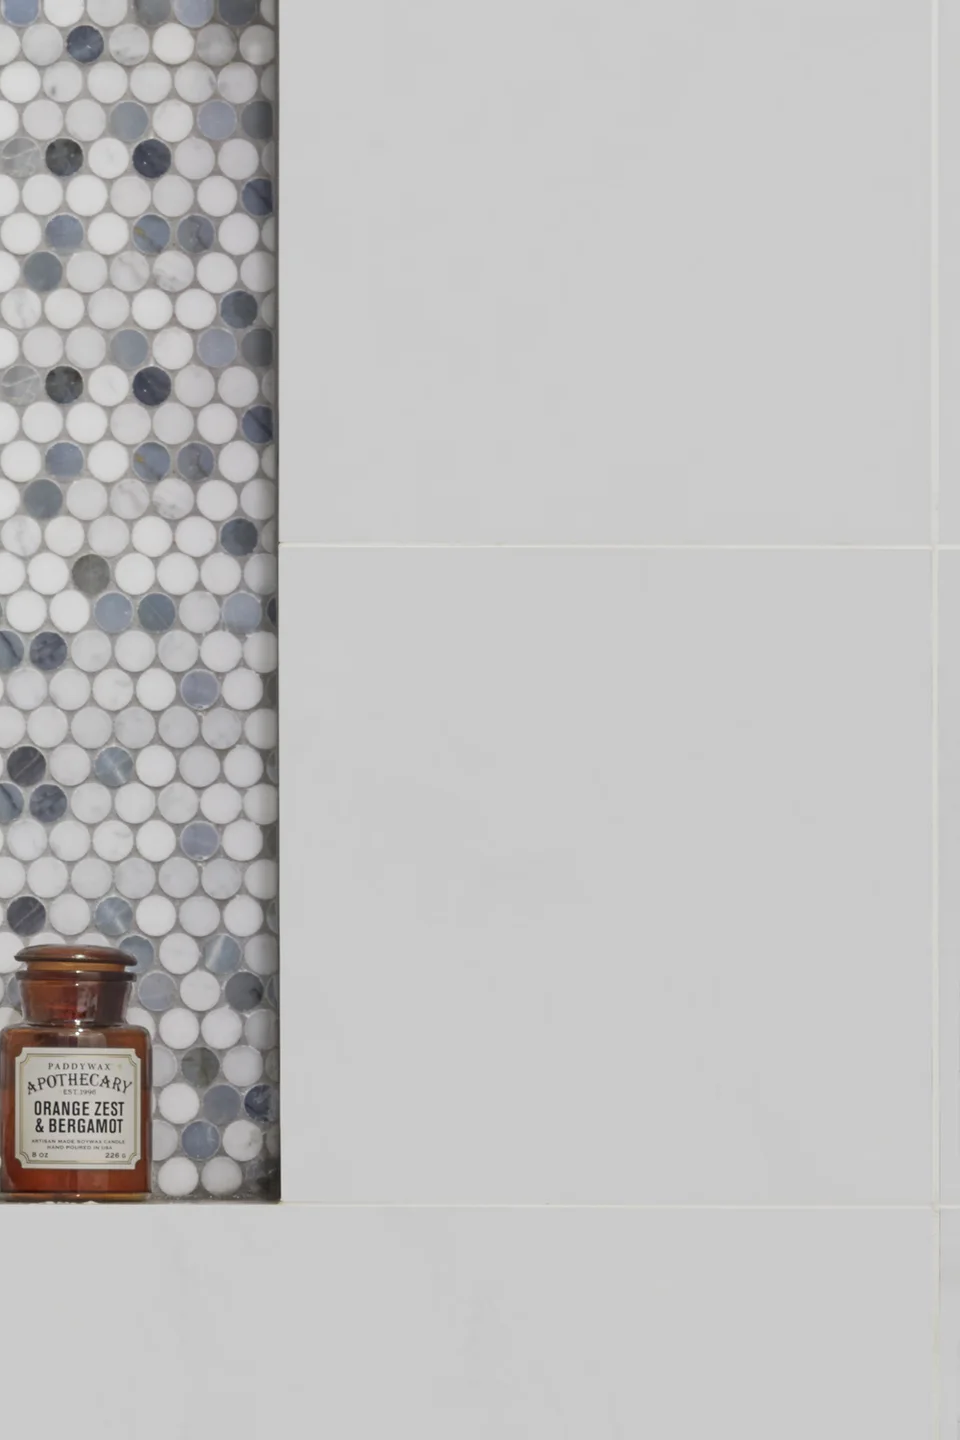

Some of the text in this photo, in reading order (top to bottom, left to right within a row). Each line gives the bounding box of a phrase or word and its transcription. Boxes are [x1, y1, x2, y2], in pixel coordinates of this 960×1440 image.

[48, 1062, 111, 1071] PADDYWAX
[27, 1073, 133, 1095] APOTHECARY
[34, 1101, 125, 1117] ORANGE ZEST
[35, 1118, 124, 1133] & BERGAMOT
